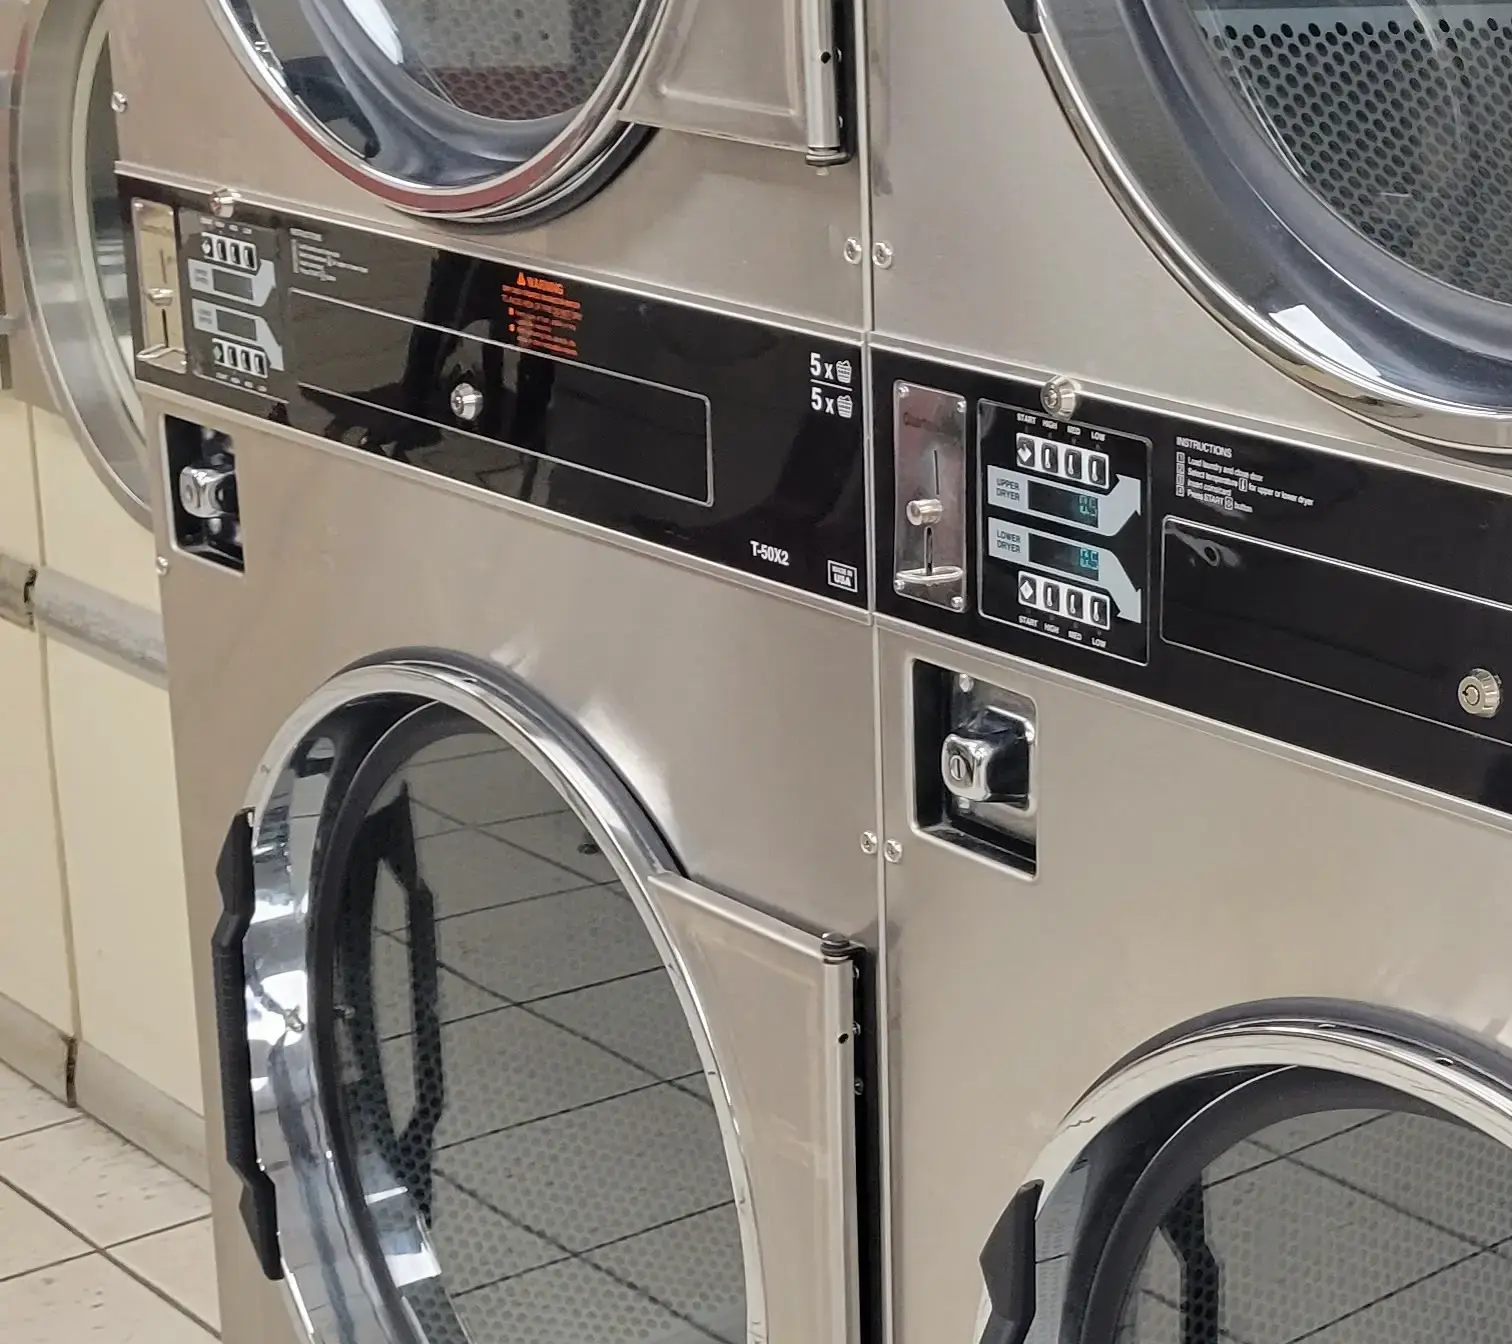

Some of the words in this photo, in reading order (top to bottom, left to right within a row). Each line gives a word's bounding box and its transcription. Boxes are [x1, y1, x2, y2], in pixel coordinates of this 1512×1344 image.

[810, 352, 821, 376] 5
[811, 387, 822, 410] 5
[1091, 431, 1106, 442] LOW
[1176, 436, 1233, 458] INSTRUCTIONS
[750, 540, 790, 566] T-50X2
[1091, 637, 1107, 649] LOW
